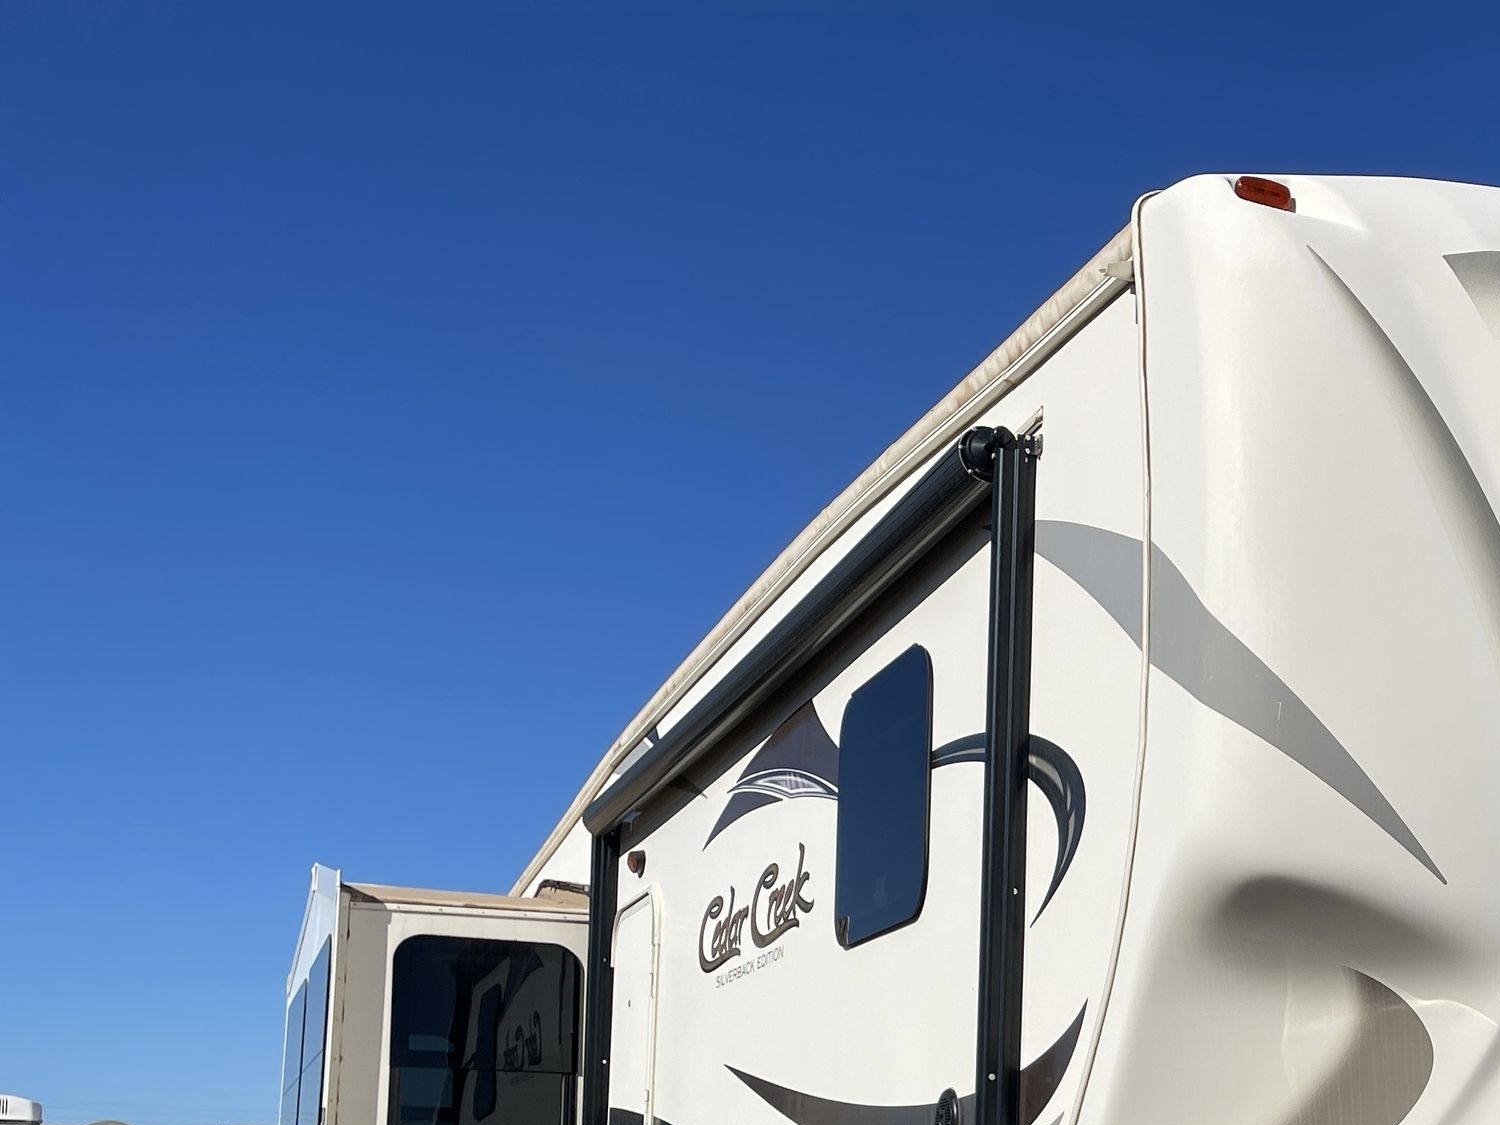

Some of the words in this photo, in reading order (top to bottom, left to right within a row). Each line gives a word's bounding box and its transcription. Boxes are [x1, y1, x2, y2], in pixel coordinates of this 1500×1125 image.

[698, 885, 750, 974] Cedar
[750, 841, 815, 949] Creek
[716, 958, 755, 988] SILVERBACK
[757, 945, 785, 969] EDITION
